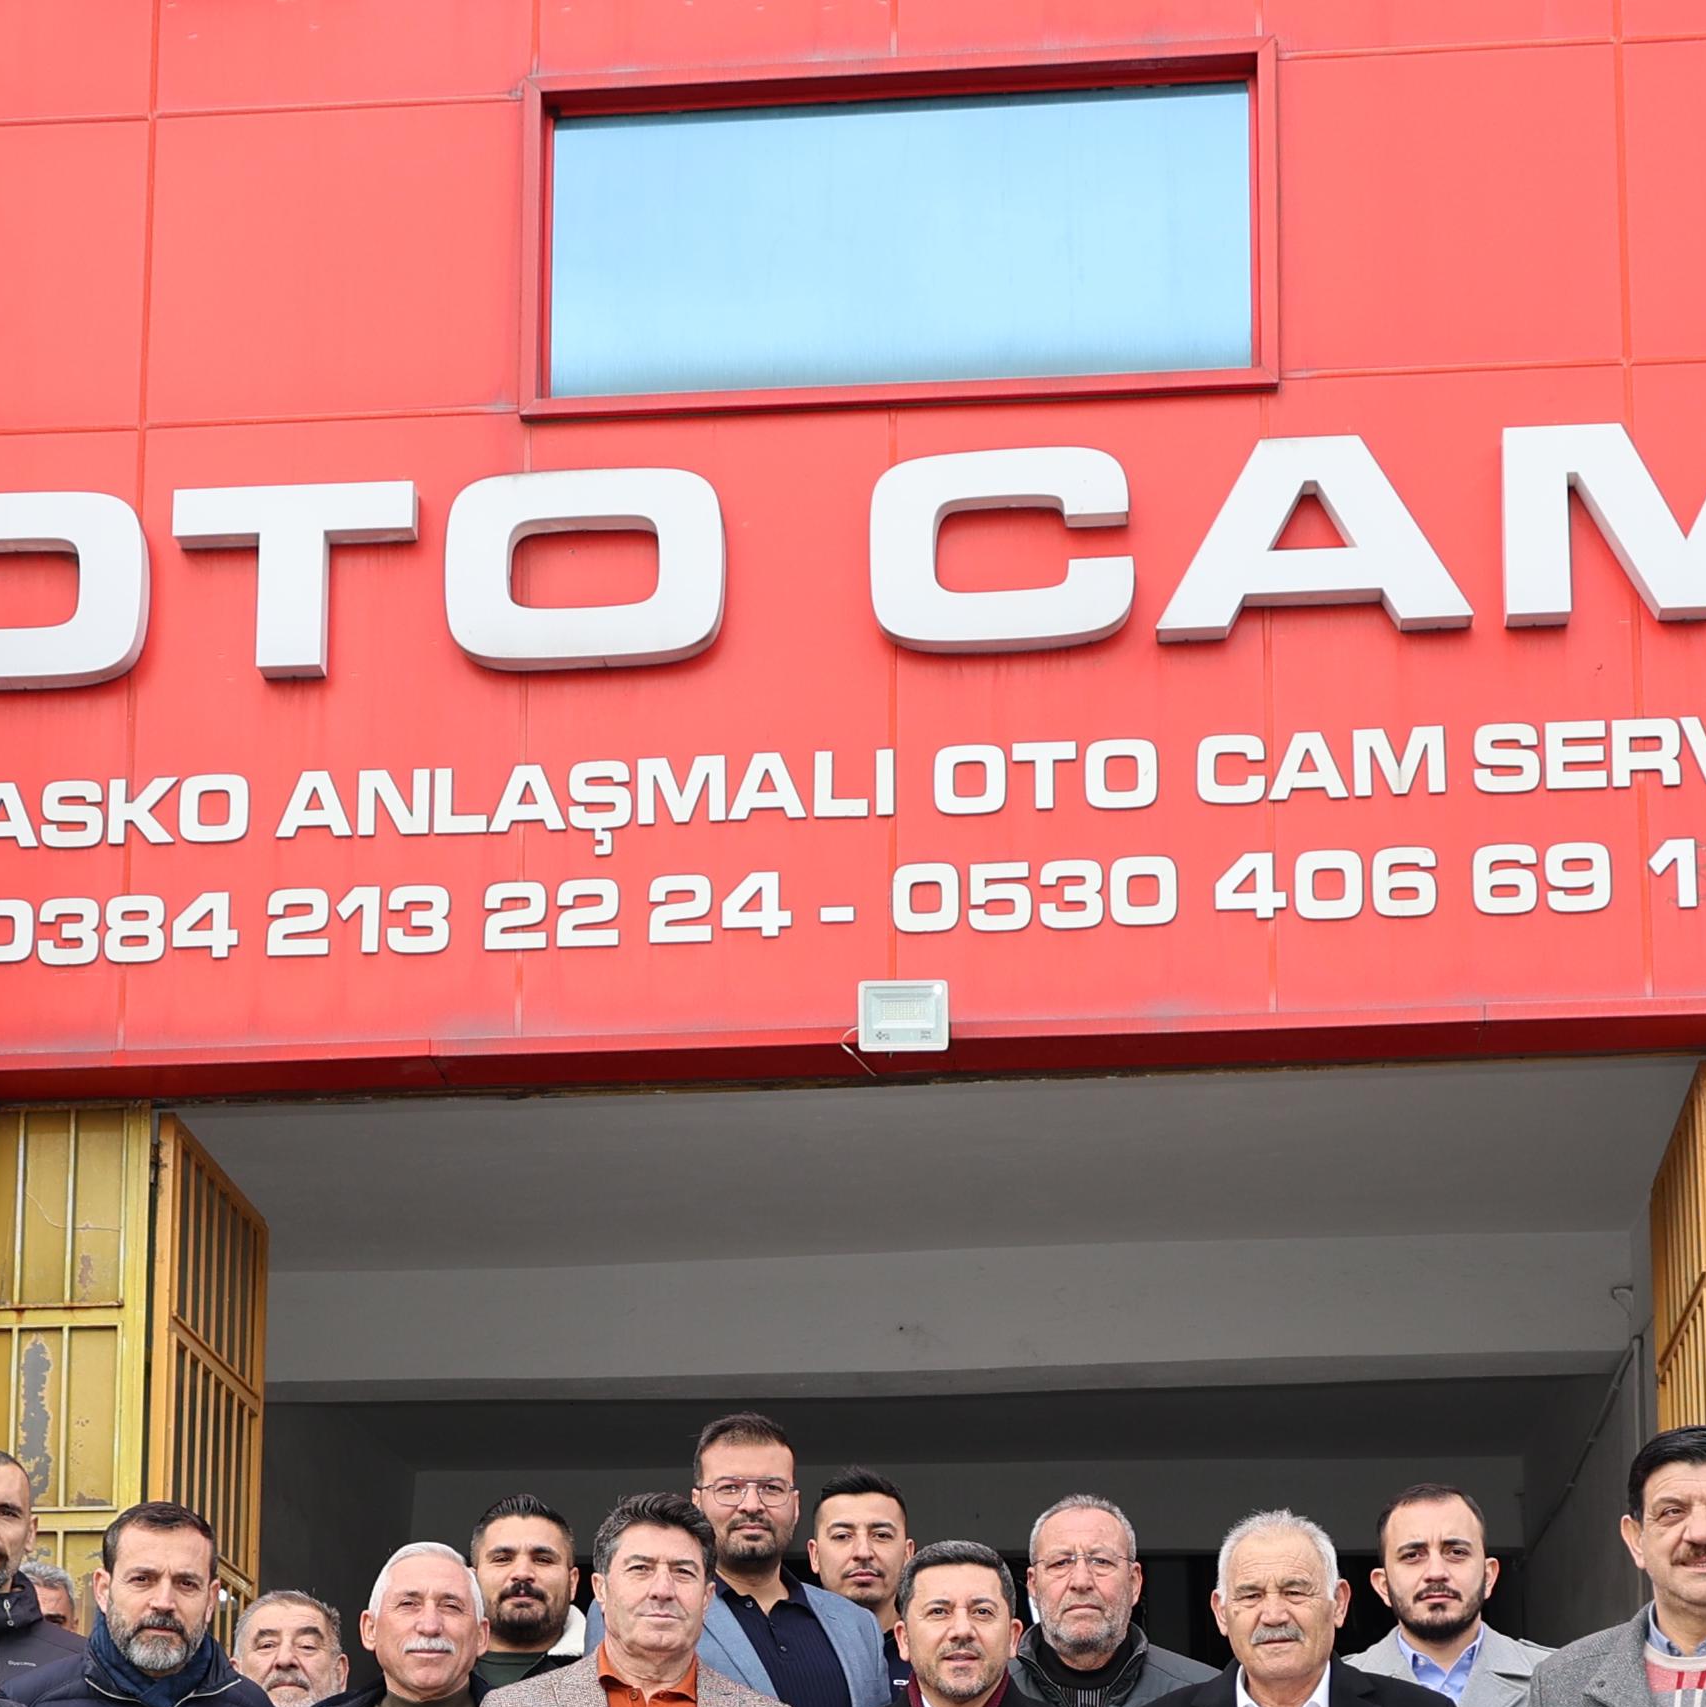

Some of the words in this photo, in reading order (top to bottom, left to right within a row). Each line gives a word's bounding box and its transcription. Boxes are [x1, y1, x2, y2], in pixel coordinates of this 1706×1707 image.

[275, 748, 893, 856] ANLAŞMALI
[933, 737, 1159, 816] OTO
[1195, 724, 1447, 806] CAM
[266, 883, 451, 956] 213
[484, 876, 621, 951] 22
[648, 870, 793, 944] 24
[891, 854, 1178, 934] 0530
[1214, 844, 1438, 921] 406
[1472, 841, 1612, 916] 69
